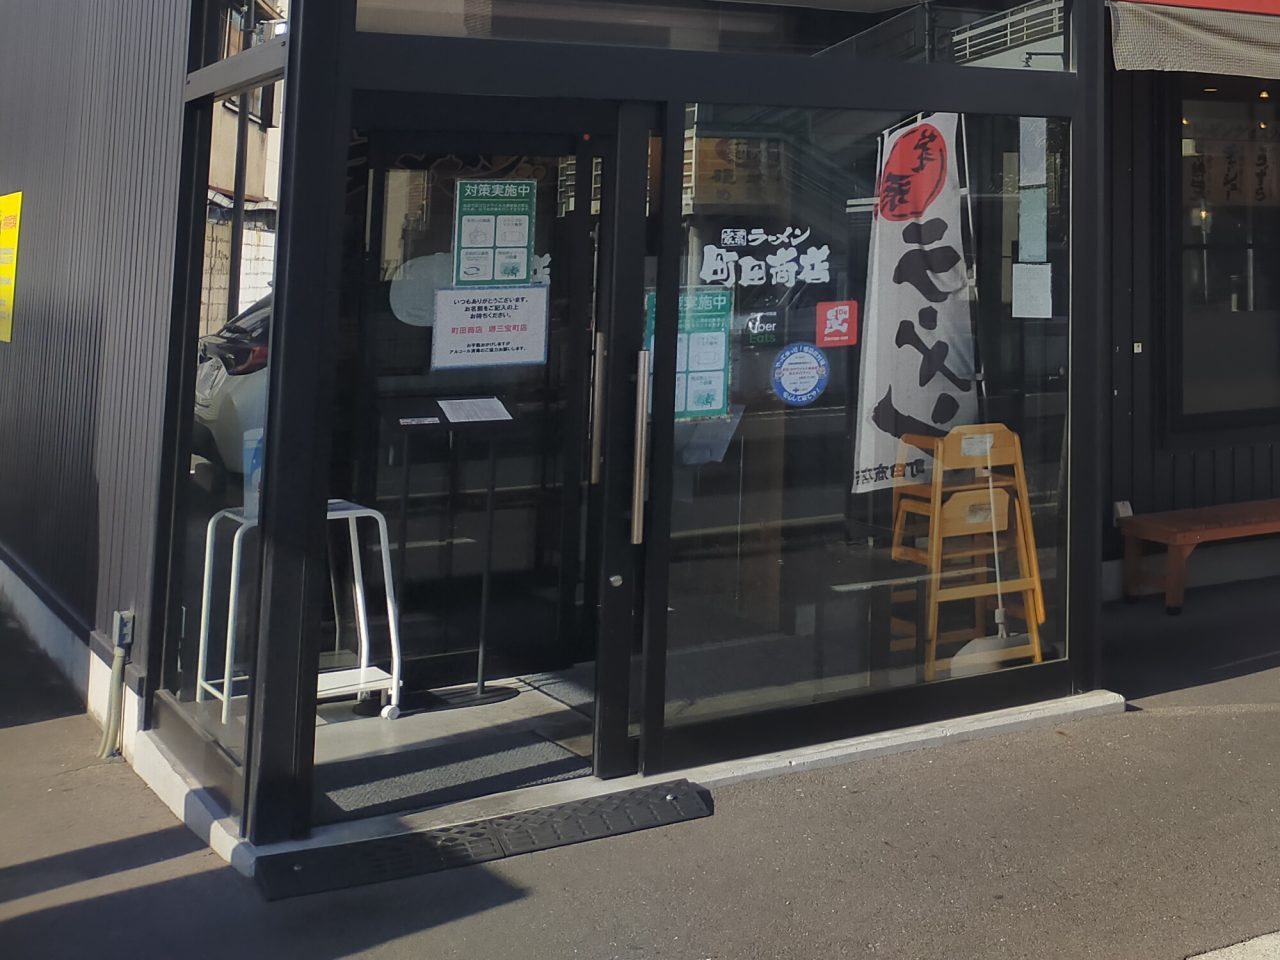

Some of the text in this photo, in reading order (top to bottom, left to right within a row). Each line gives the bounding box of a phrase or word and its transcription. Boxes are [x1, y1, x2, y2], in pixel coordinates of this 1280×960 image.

[464, 183, 530, 197] 対策実施中
[748, 226, 811, 246] ラーメン
[699, 244, 830, 288] 町田商店
